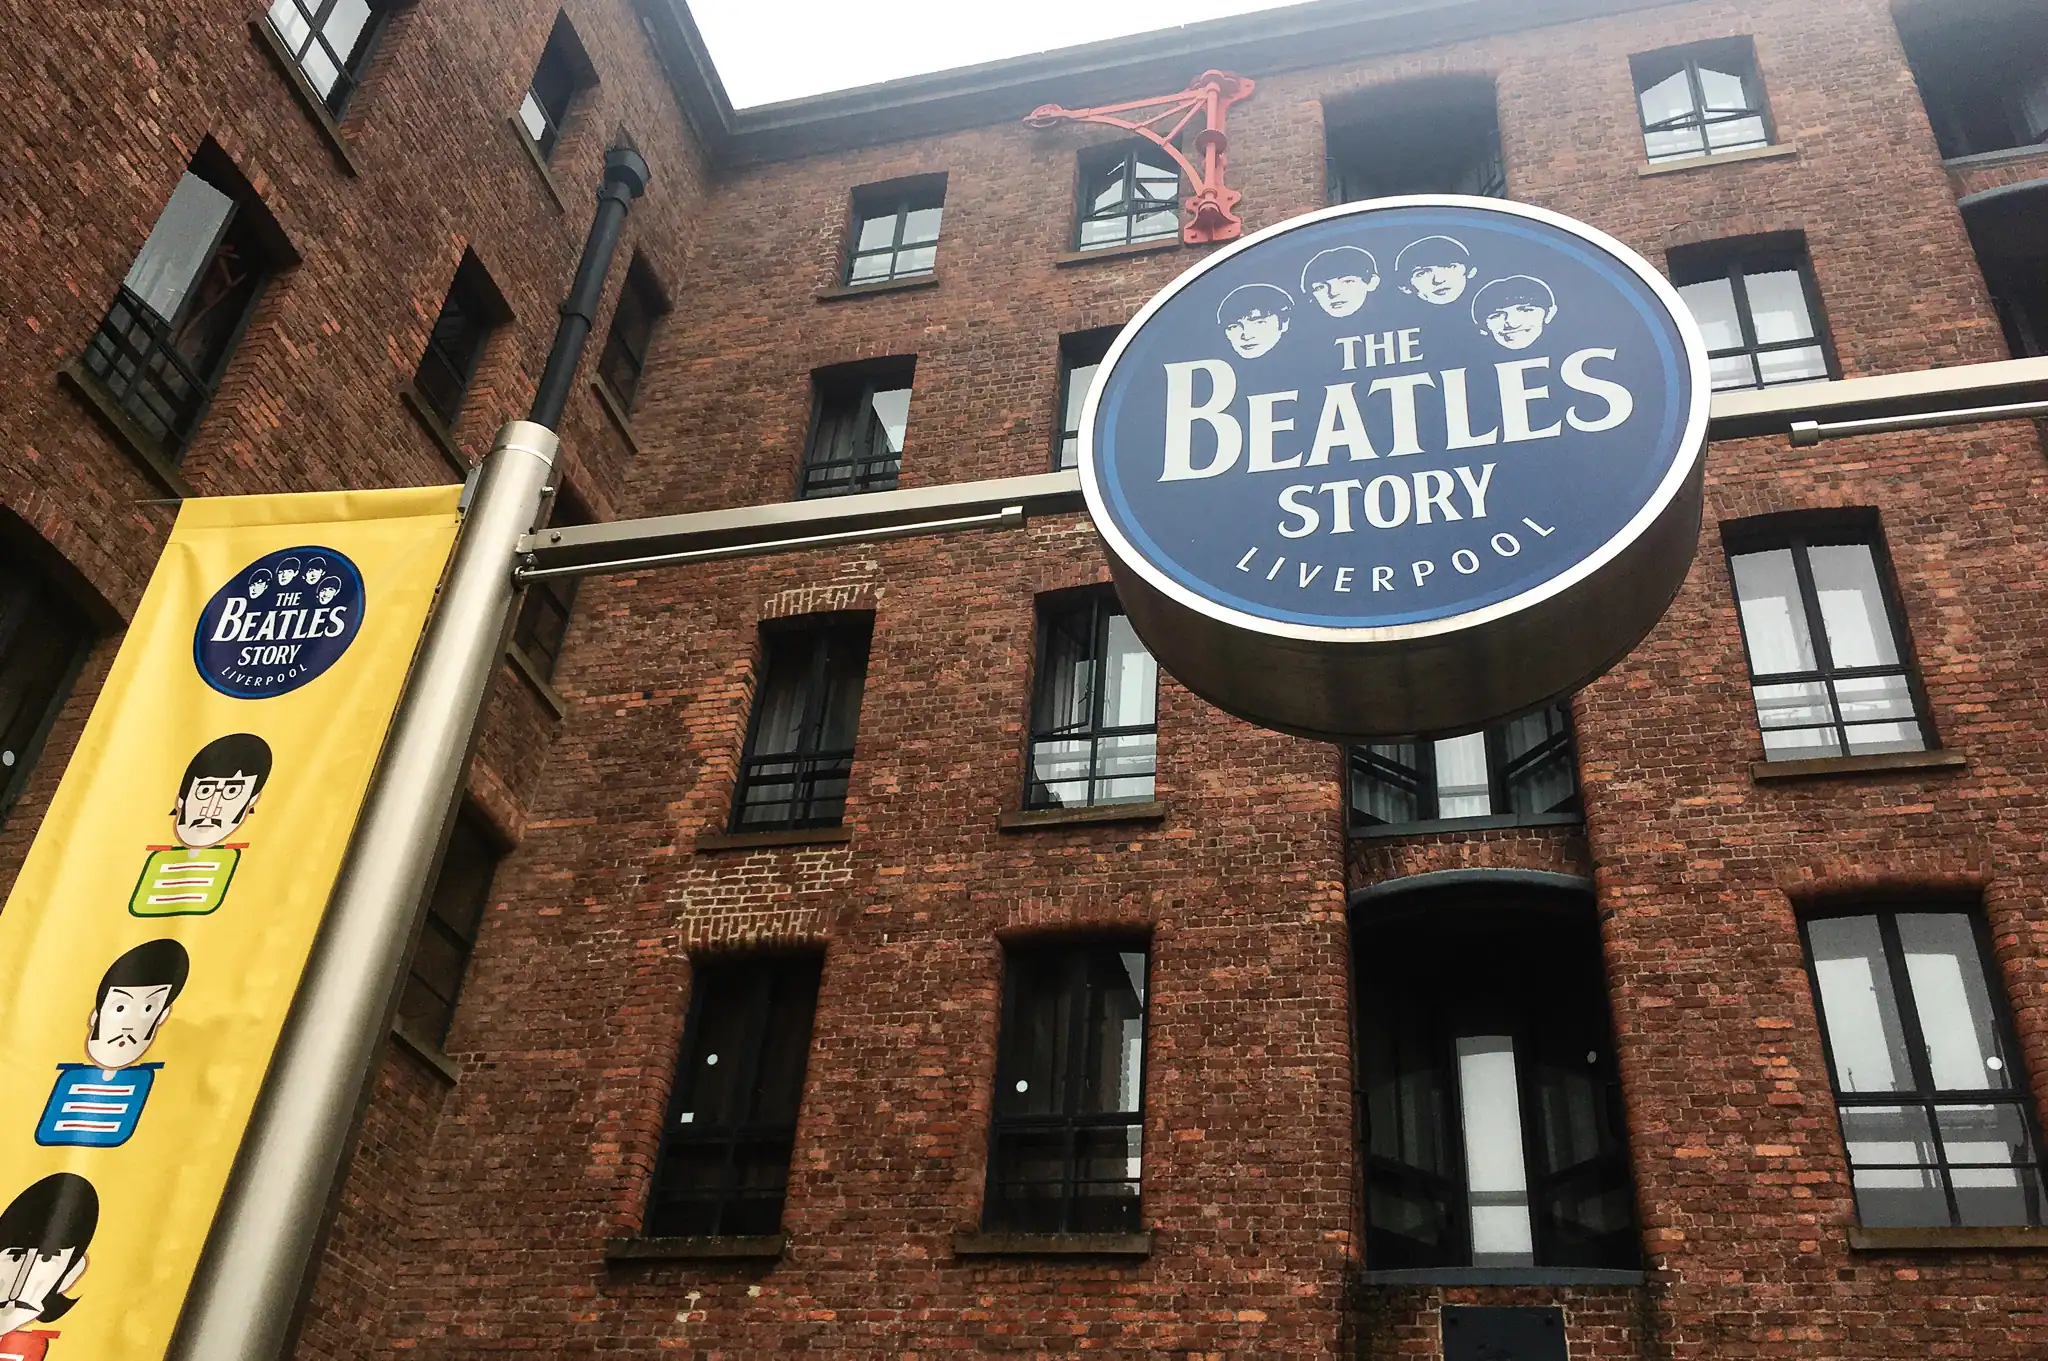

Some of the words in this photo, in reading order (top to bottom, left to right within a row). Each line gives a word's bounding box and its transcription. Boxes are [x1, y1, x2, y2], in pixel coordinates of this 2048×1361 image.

[1334, 327, 1425, 371] THE
[1157, 347, 1634, 483] BEATLES
[1277, 462, 1497, 539] STORY
[1235, 516, 1556, 593] LIVERPOOL
[210, 596, 348, 642] BEATLES
[275, 591, 302, 607] THE
[221, 663, 307, 687] LIVERPOOL
[237, 644, 302, 666] STORY
